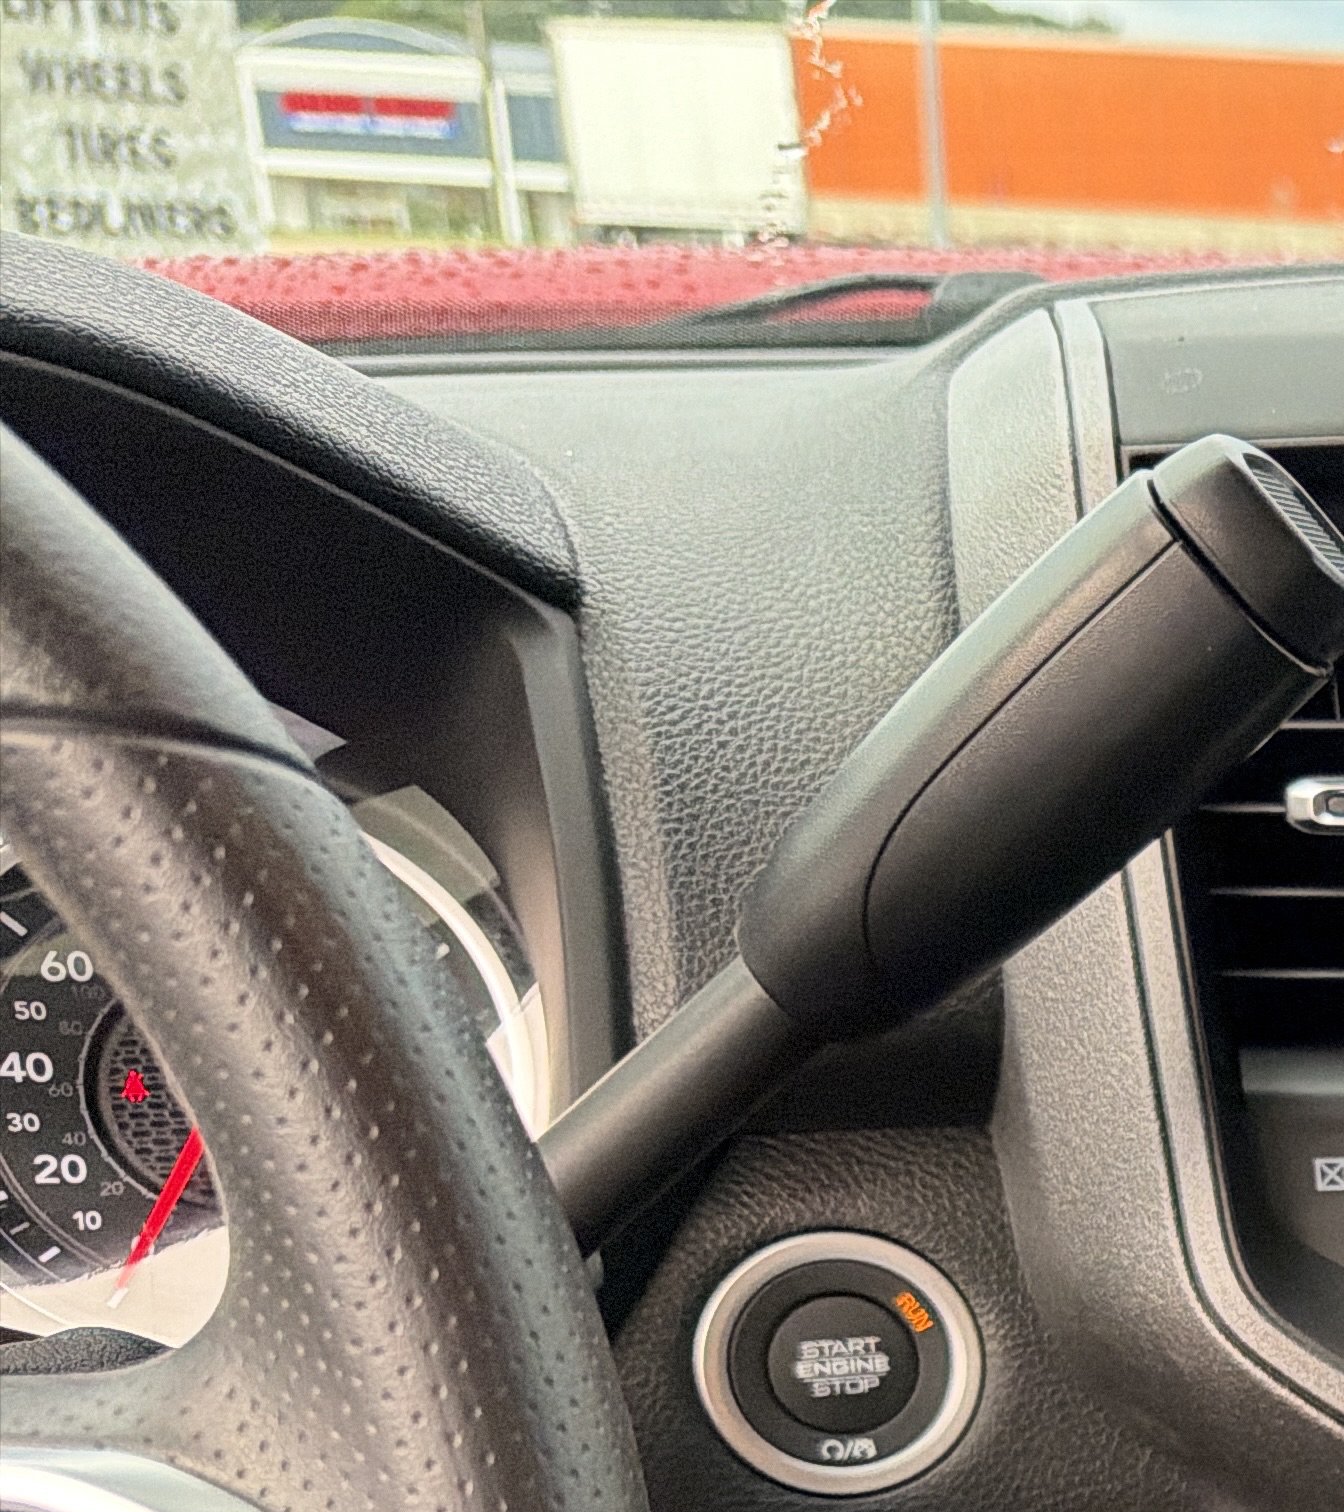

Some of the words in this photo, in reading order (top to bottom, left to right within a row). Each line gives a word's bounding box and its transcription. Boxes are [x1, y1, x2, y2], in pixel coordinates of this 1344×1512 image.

[20, 50, 187, 105] WHEELS
[57, 125, 177, 171] TIRES
[40, 950, 94, 983] 60
[14, 1001, 47, 1021] 50
[0, 1051, 54, 1083] 40
[48, 1081, 74, 1098] 60
[6, 1112, 40, 1132] 30
[61, 1132, 86, 1147] 40
[33, 1154, 88, 1184] 20
[100, 1181, 124, 1196] 20
[72, 1210, 102, 1231] 10
[895, 1291, 934, 1333] RUN
[799, 1336, 882, 1359] START
[795, 1353, 890, 1379] ENGINE
[811, 1376, 880, 1398] STOP
